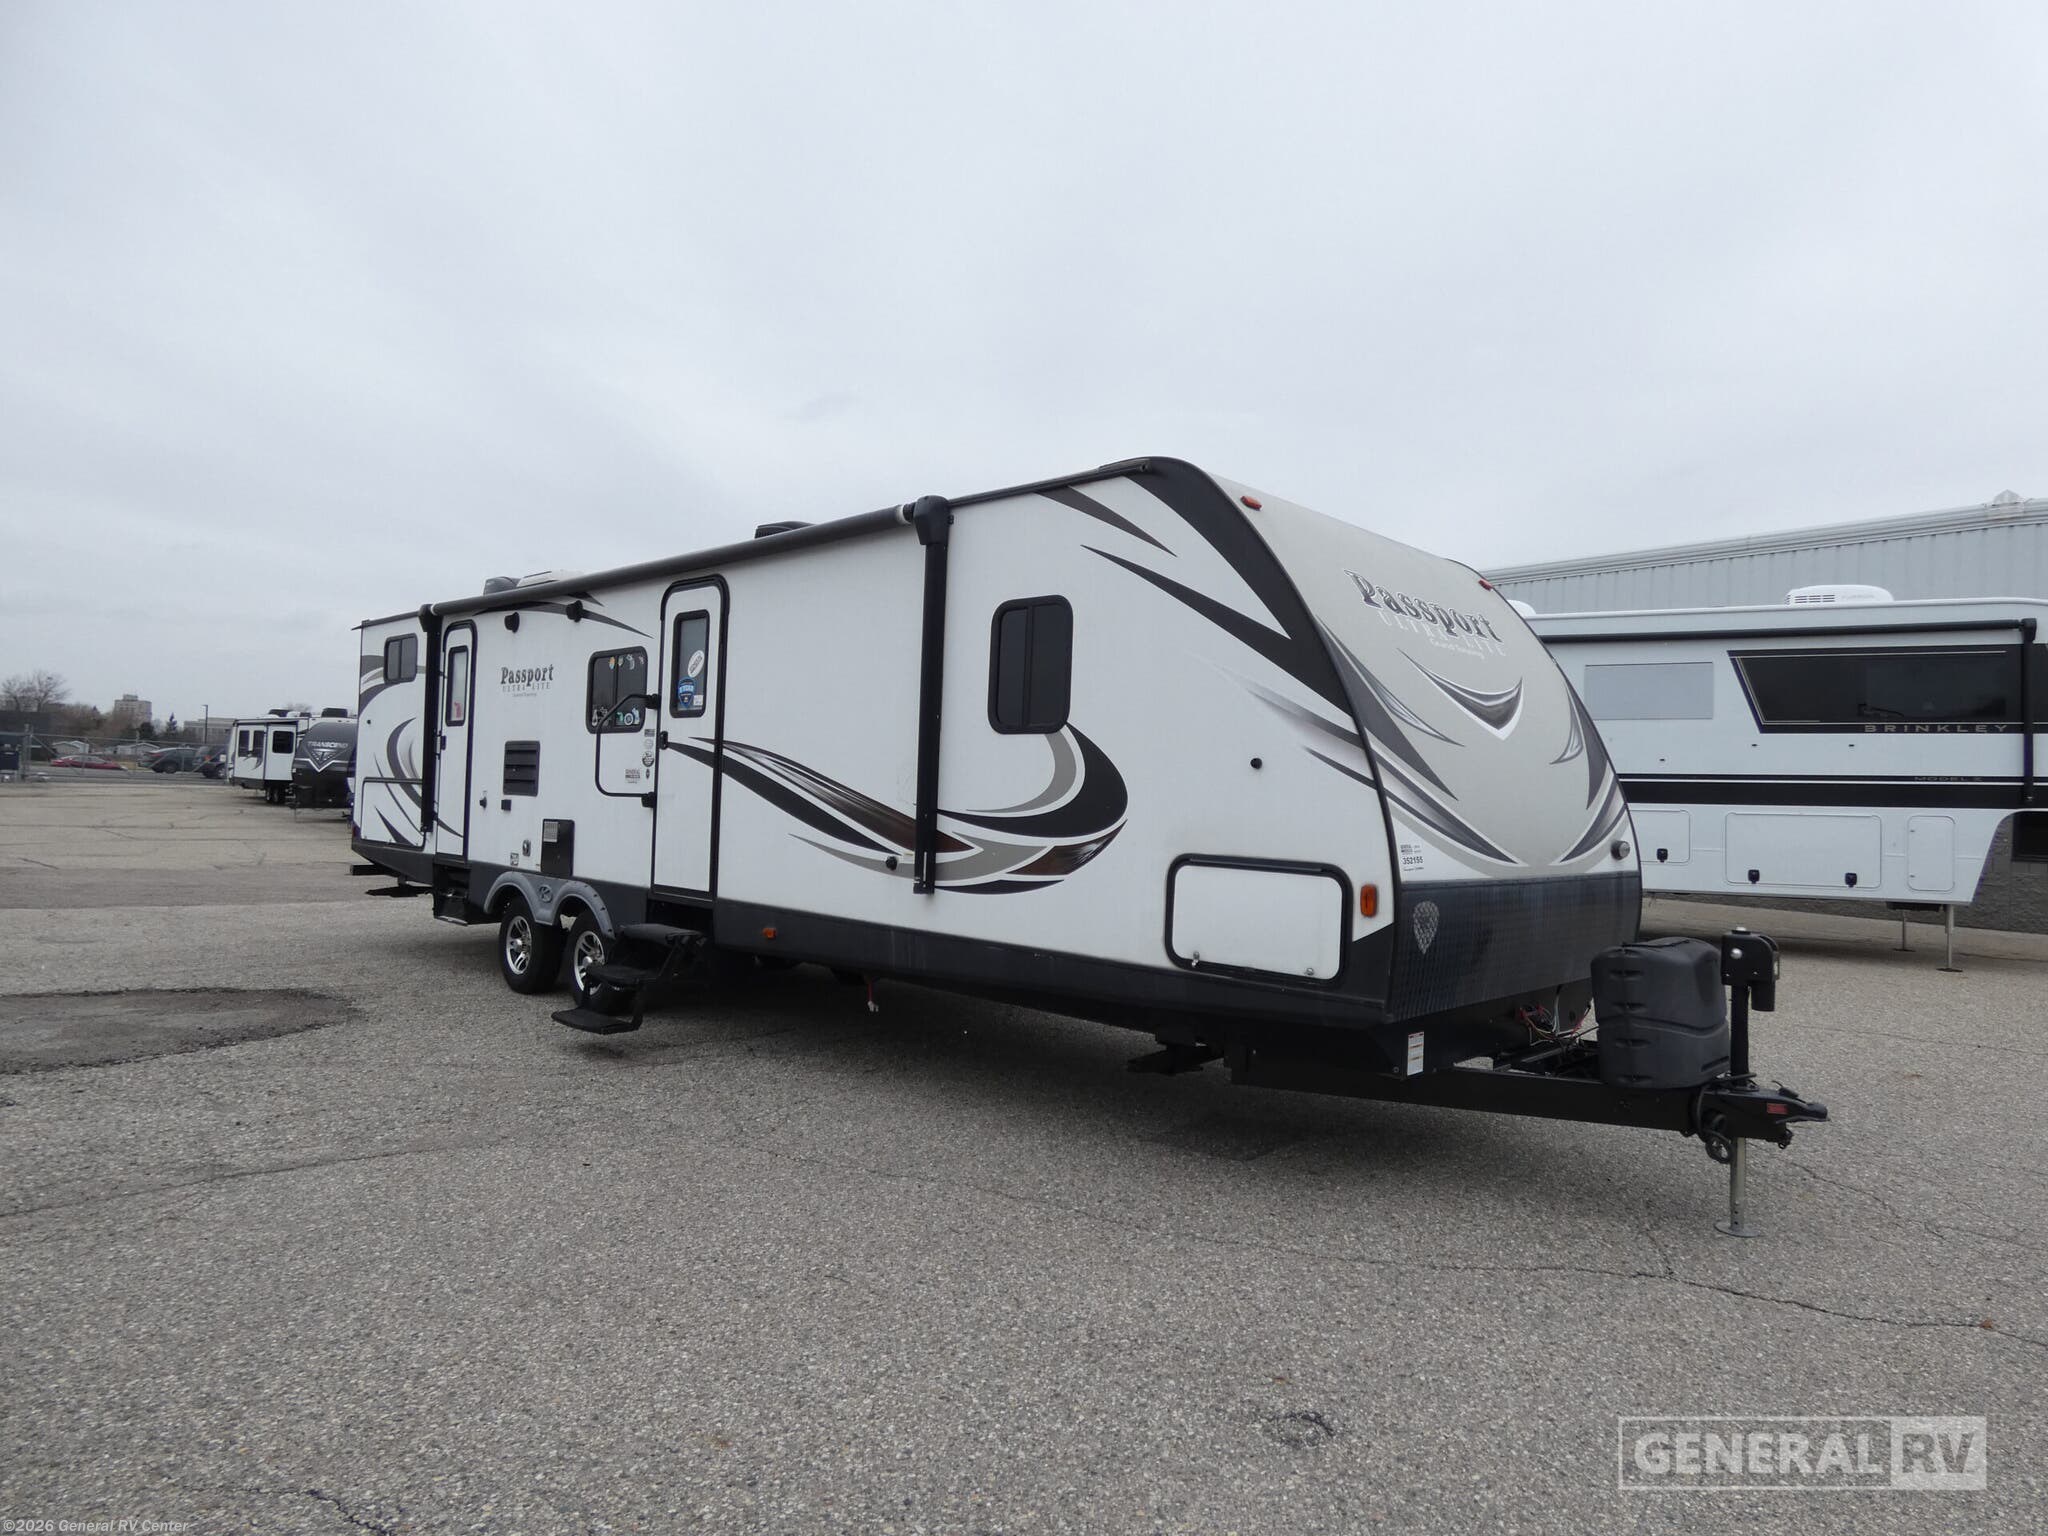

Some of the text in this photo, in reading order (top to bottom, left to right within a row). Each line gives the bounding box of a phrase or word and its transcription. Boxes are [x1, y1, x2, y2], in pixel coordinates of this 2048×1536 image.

[1343, 569, 1503, 643] Passport
[500, 663, 554, 687] Passport
[1864, 724, 2008, 733] BRINKLEY
